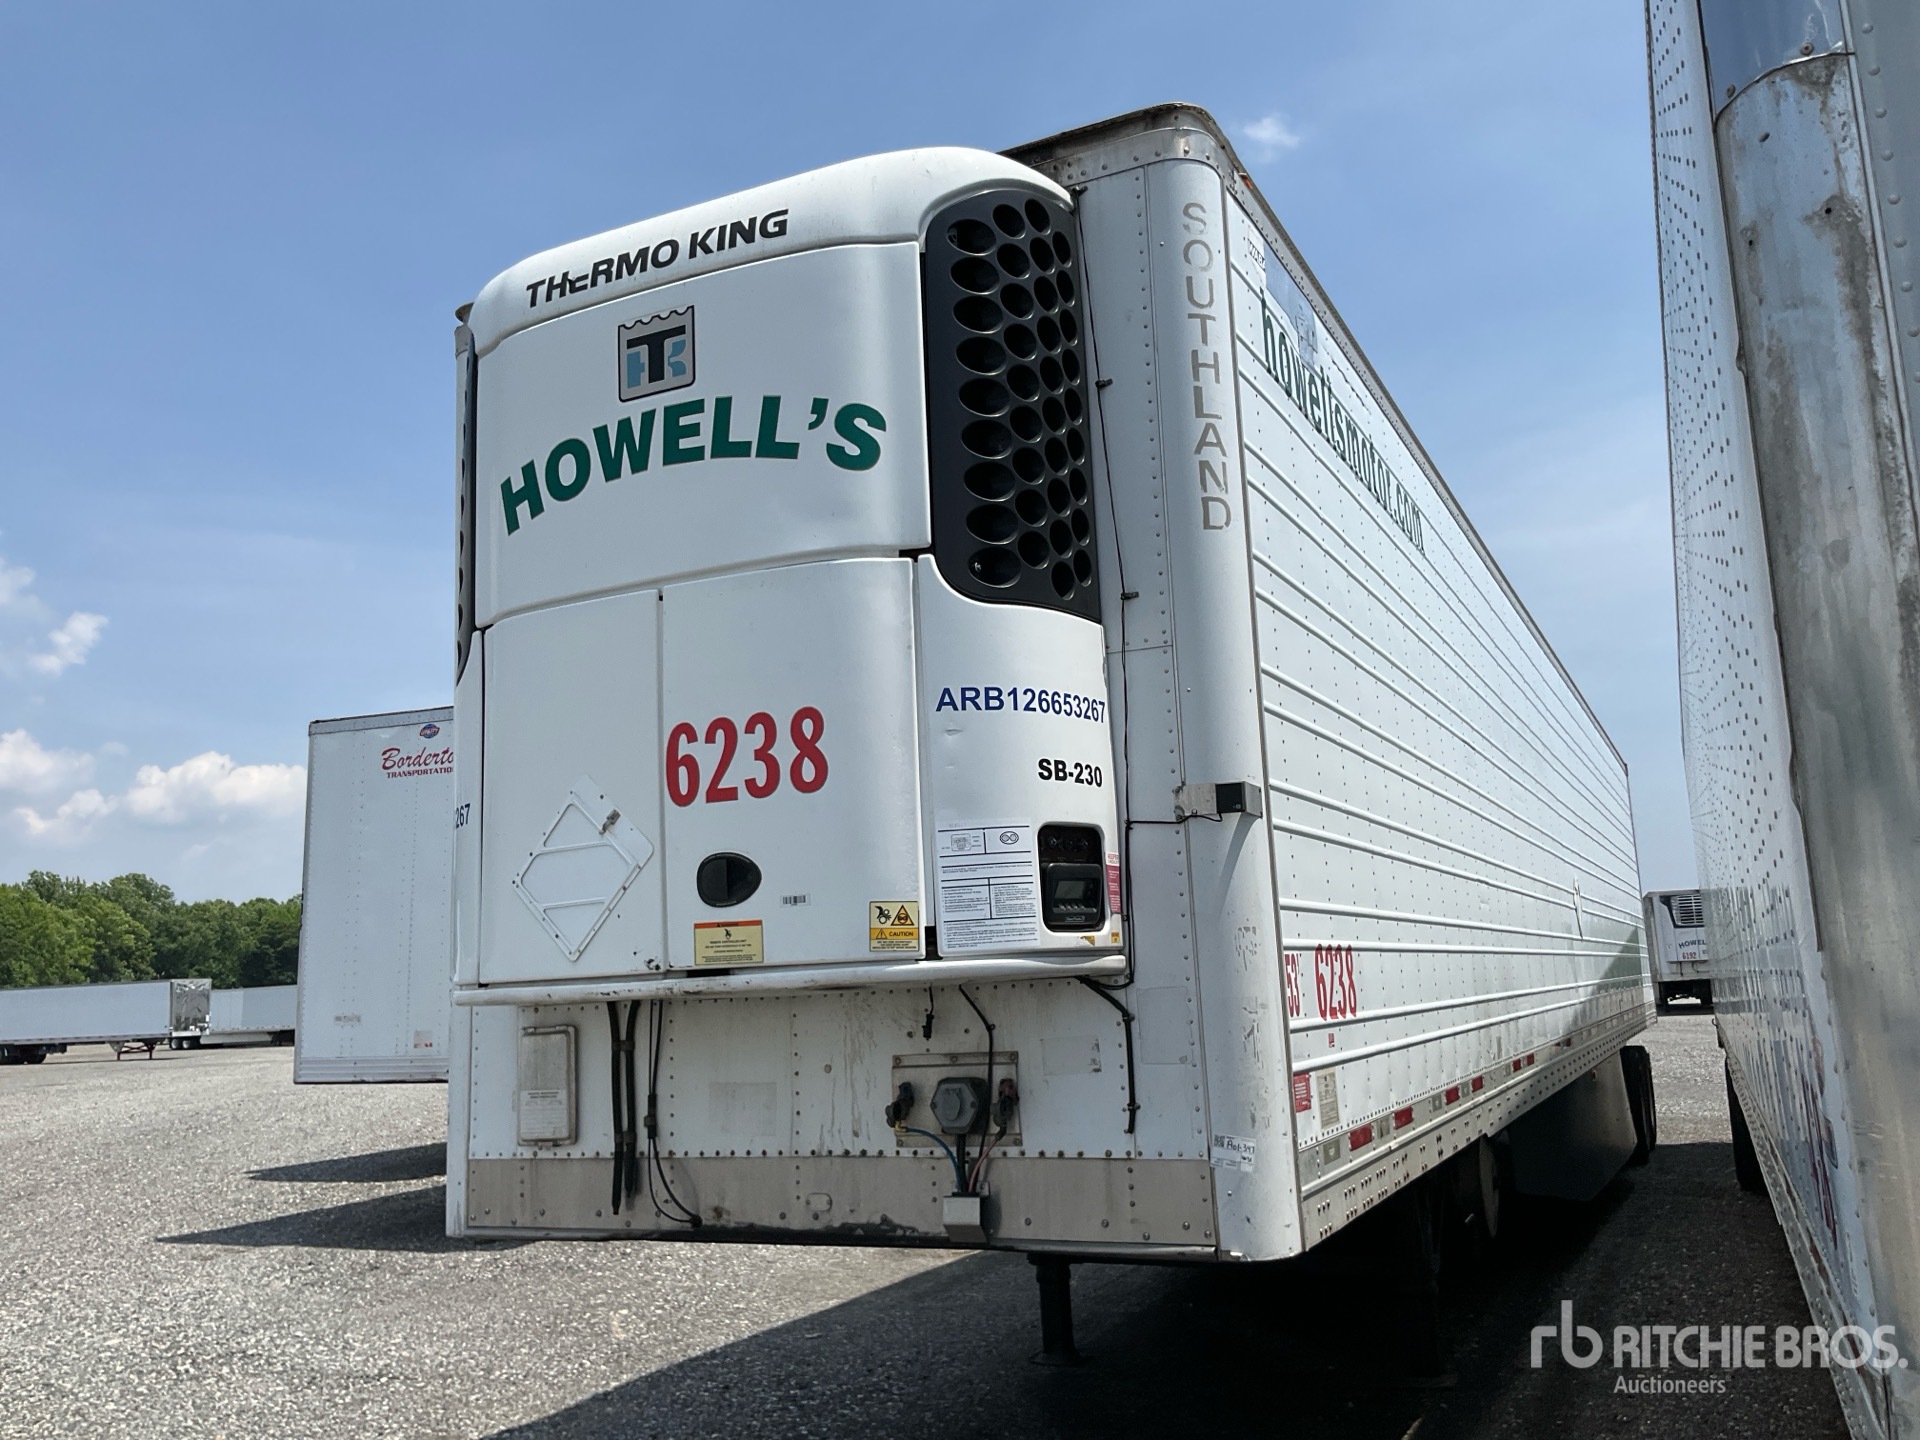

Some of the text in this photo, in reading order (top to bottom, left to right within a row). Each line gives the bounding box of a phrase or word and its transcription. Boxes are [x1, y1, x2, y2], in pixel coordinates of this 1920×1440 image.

[526, 209, 789, 308] THERMO KING
[1183, 202, 1232, 531] SOUTHLAND
[500, 395, 887, 536] HOWELL'S
[1260, 286, 1426, 557] howellsmotor.com
[935, 686, 1106, 724] ARB126653267
[387, 766, 454, 779] TRANSPORTATIO
[666, 706, 829, 807] 6238
[1037, 758, 1103, 788] SB-230
[455, 803, 471, 829] 267
[1314, 943, 1357, 1021] 6238
